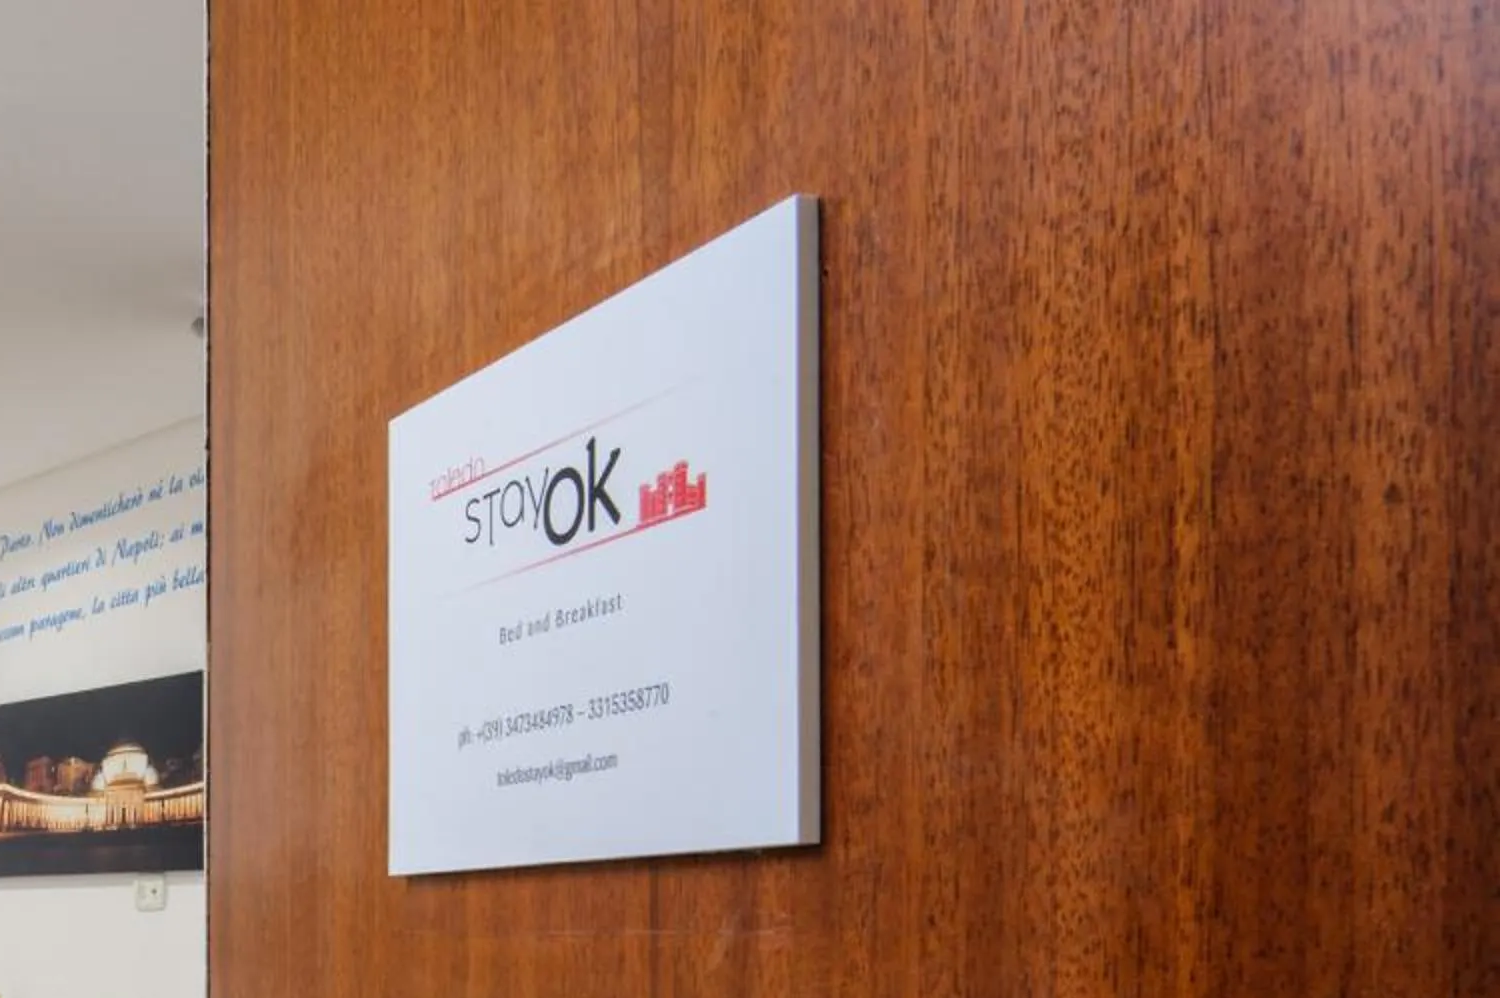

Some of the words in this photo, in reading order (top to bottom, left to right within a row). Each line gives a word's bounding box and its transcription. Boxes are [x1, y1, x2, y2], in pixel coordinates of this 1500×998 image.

[499, 618, 523, 646] Bed
[527, 611, 550, 637] and
[555, 592, 622, 628] Breakfast
